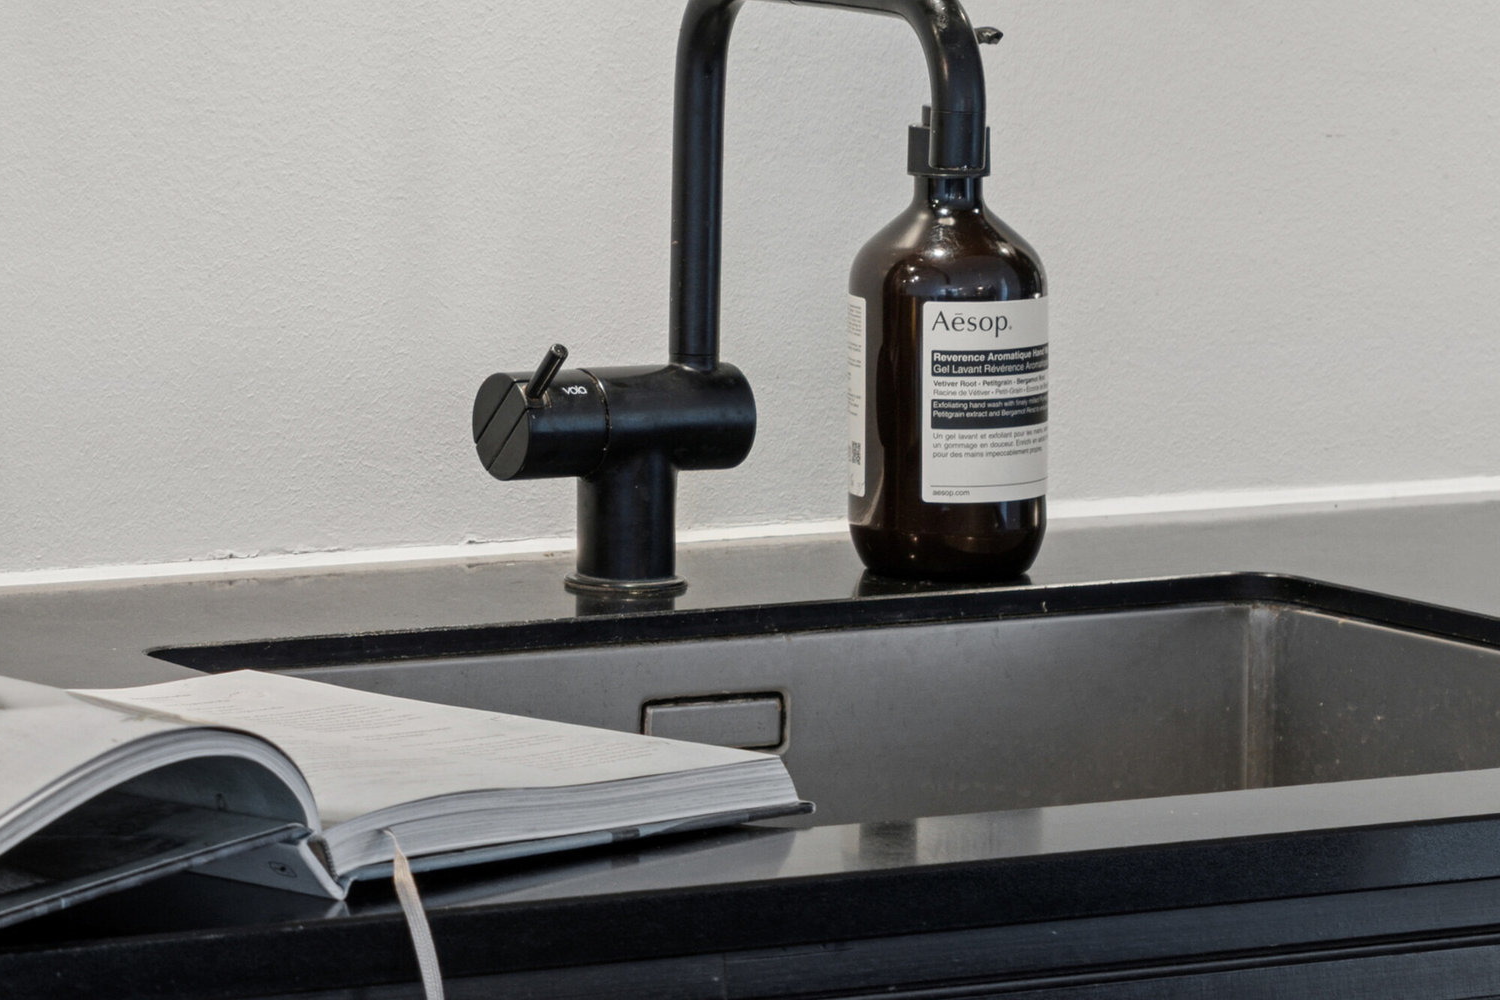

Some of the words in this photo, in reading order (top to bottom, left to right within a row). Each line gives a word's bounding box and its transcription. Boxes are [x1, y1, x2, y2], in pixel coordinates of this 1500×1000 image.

[933, 352, 985, 362] Reverence
[987, 350, 1032, 362] Aromatique
[933, 364, 950, 374] Gel
[952, 364, 982, 374] Lavant
[984, 363, 1024, 373] Révérence
[933, 388, 957, 396] Racine
[958, 388, 967, 396] de
[933, 401, 968, 410] Exfoliating
[969, 401, 986, 409] hand
[987, 400, 1003, 408] wash
[933, 410, 965, 420] Petitgrain
[966, 410, 987, 418] extract
[988, 409, 1000, 417] and
[933, 432, 942, 440] Un
[945, 432, 956, 441] gel
[958, 432, 978, 440] lavant
[944, 442, 978, 450] gommage
[933, 451, 948, 459] pour
[964, 450, 984, 458] mains
[932, 490, 970, 498] aesop.com
